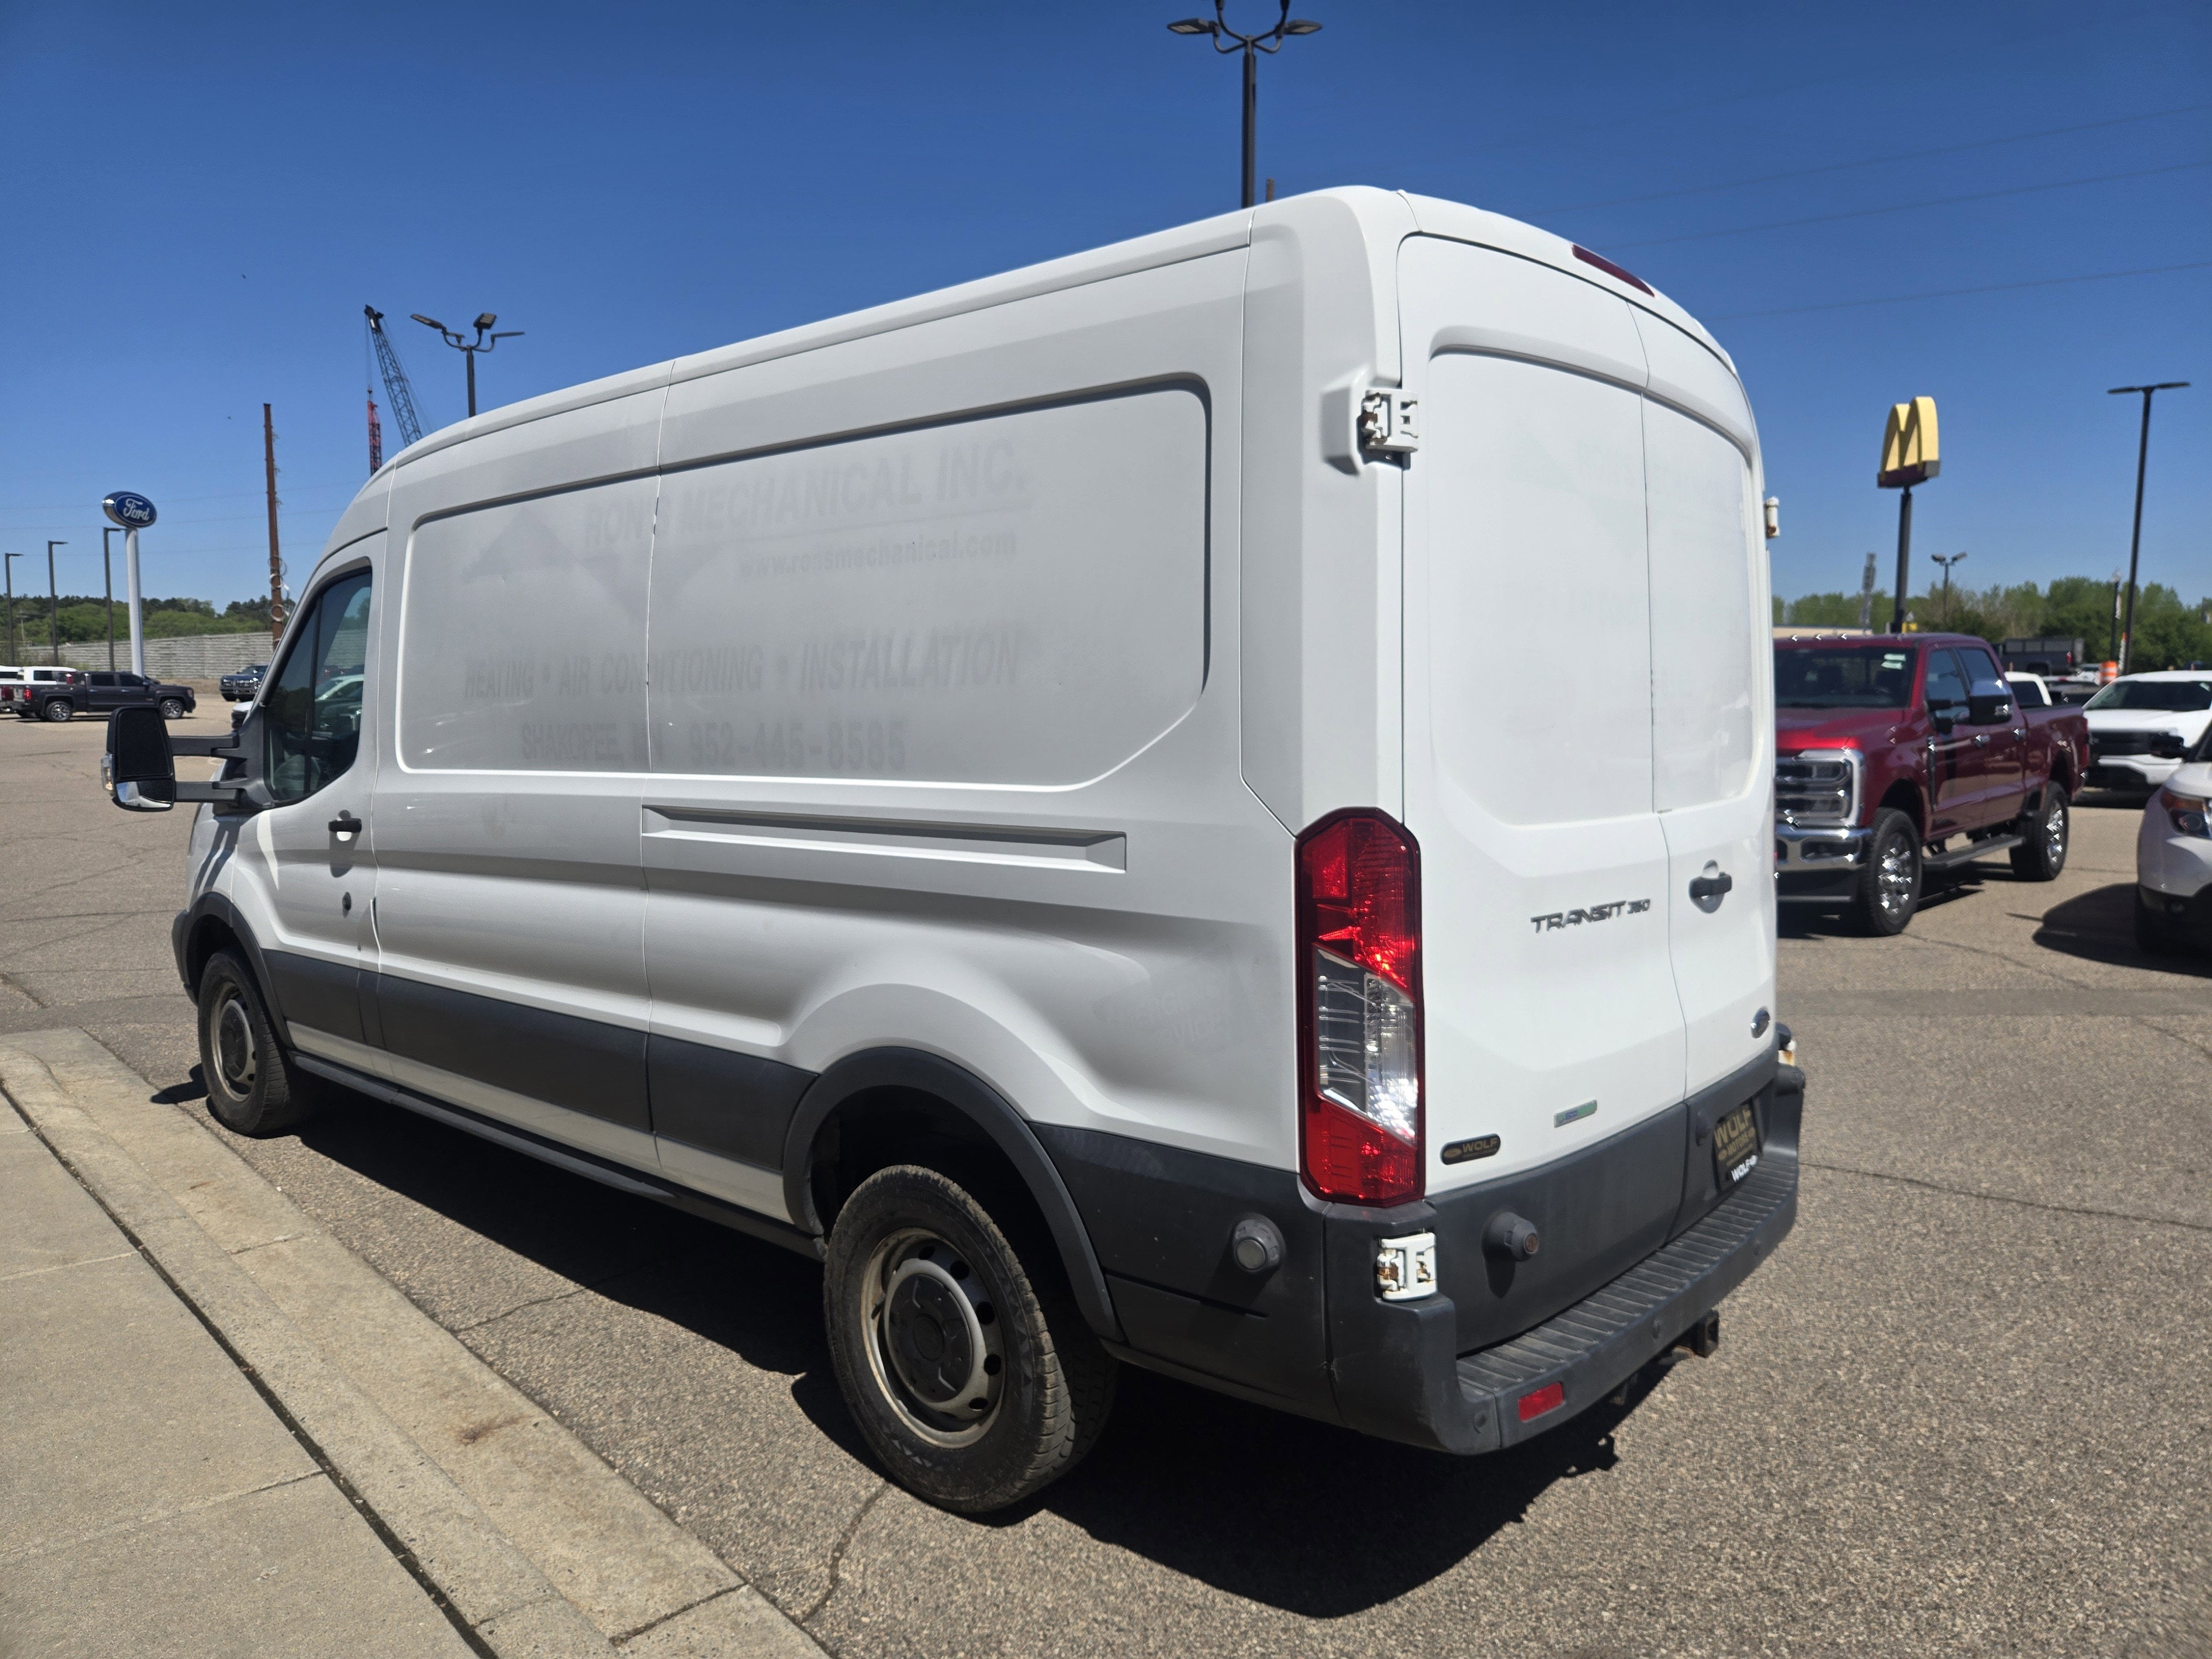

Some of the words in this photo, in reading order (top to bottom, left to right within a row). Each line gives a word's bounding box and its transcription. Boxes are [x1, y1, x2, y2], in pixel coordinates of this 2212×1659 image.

[679, 452, 922, 535] MECHANICAL
[938, 437, 1030, 500] INC.
[123, 498, 149, 520] Ford
[464, 658, 534, 698] HEATING
[559, 654, 591, 695] AIR
[801, 627, 1020, 691] INSTALLATION
[688, 718, 906, 770] 952-445-8585
[1531, 900, 1626, 933] TRANSIT
[1462, 1138, 1499, 1154] WOLF
[1715, 1109, 1751, 1149] WOLF
